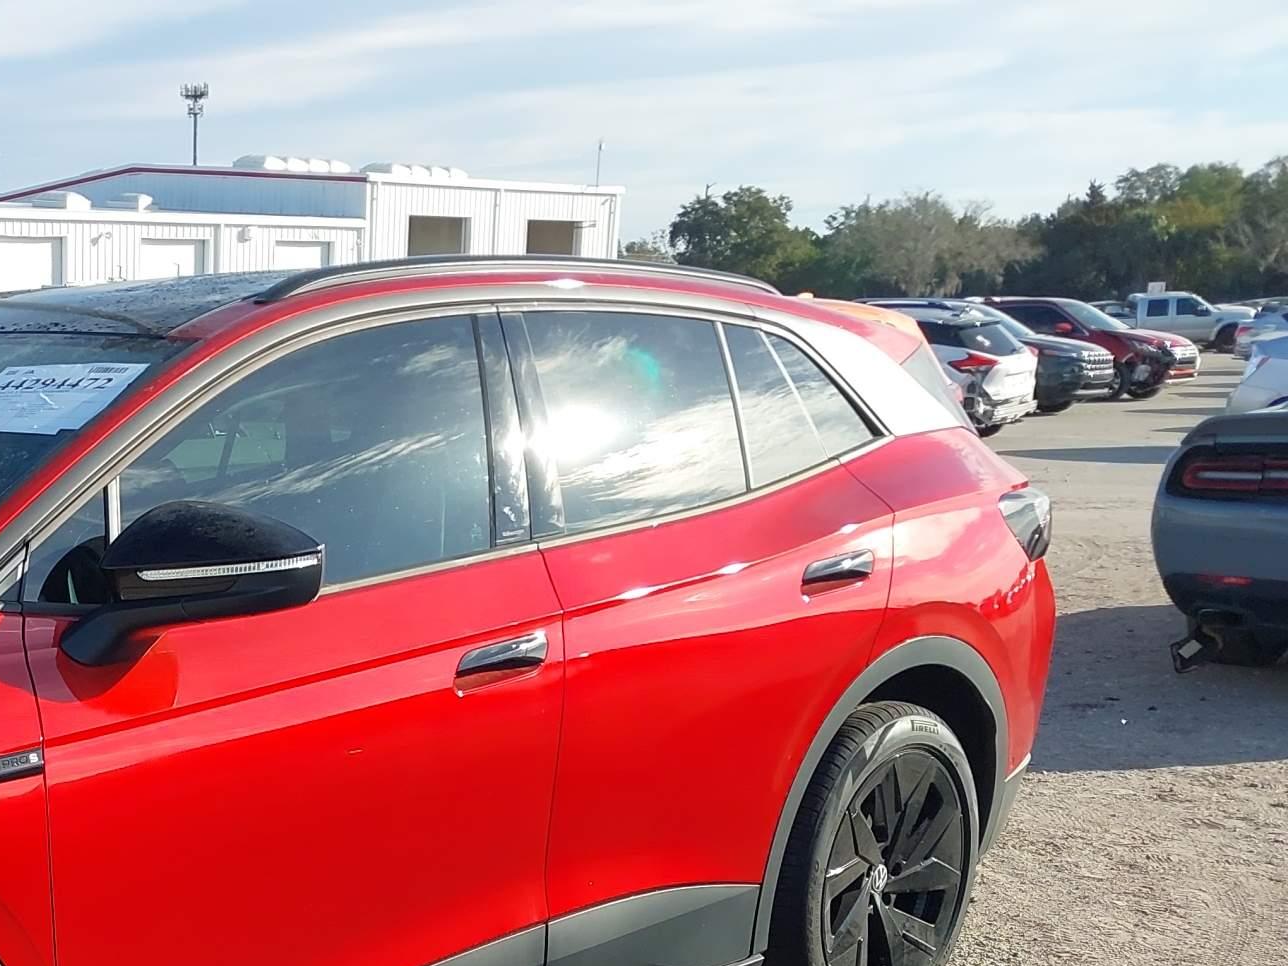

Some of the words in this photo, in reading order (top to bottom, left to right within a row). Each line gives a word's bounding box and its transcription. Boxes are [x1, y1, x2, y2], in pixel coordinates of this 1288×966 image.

[910, 719, 940, 735] PIRELLI
[1, 755, 28, 769] PRO
[29, 753, 39, 763] S
